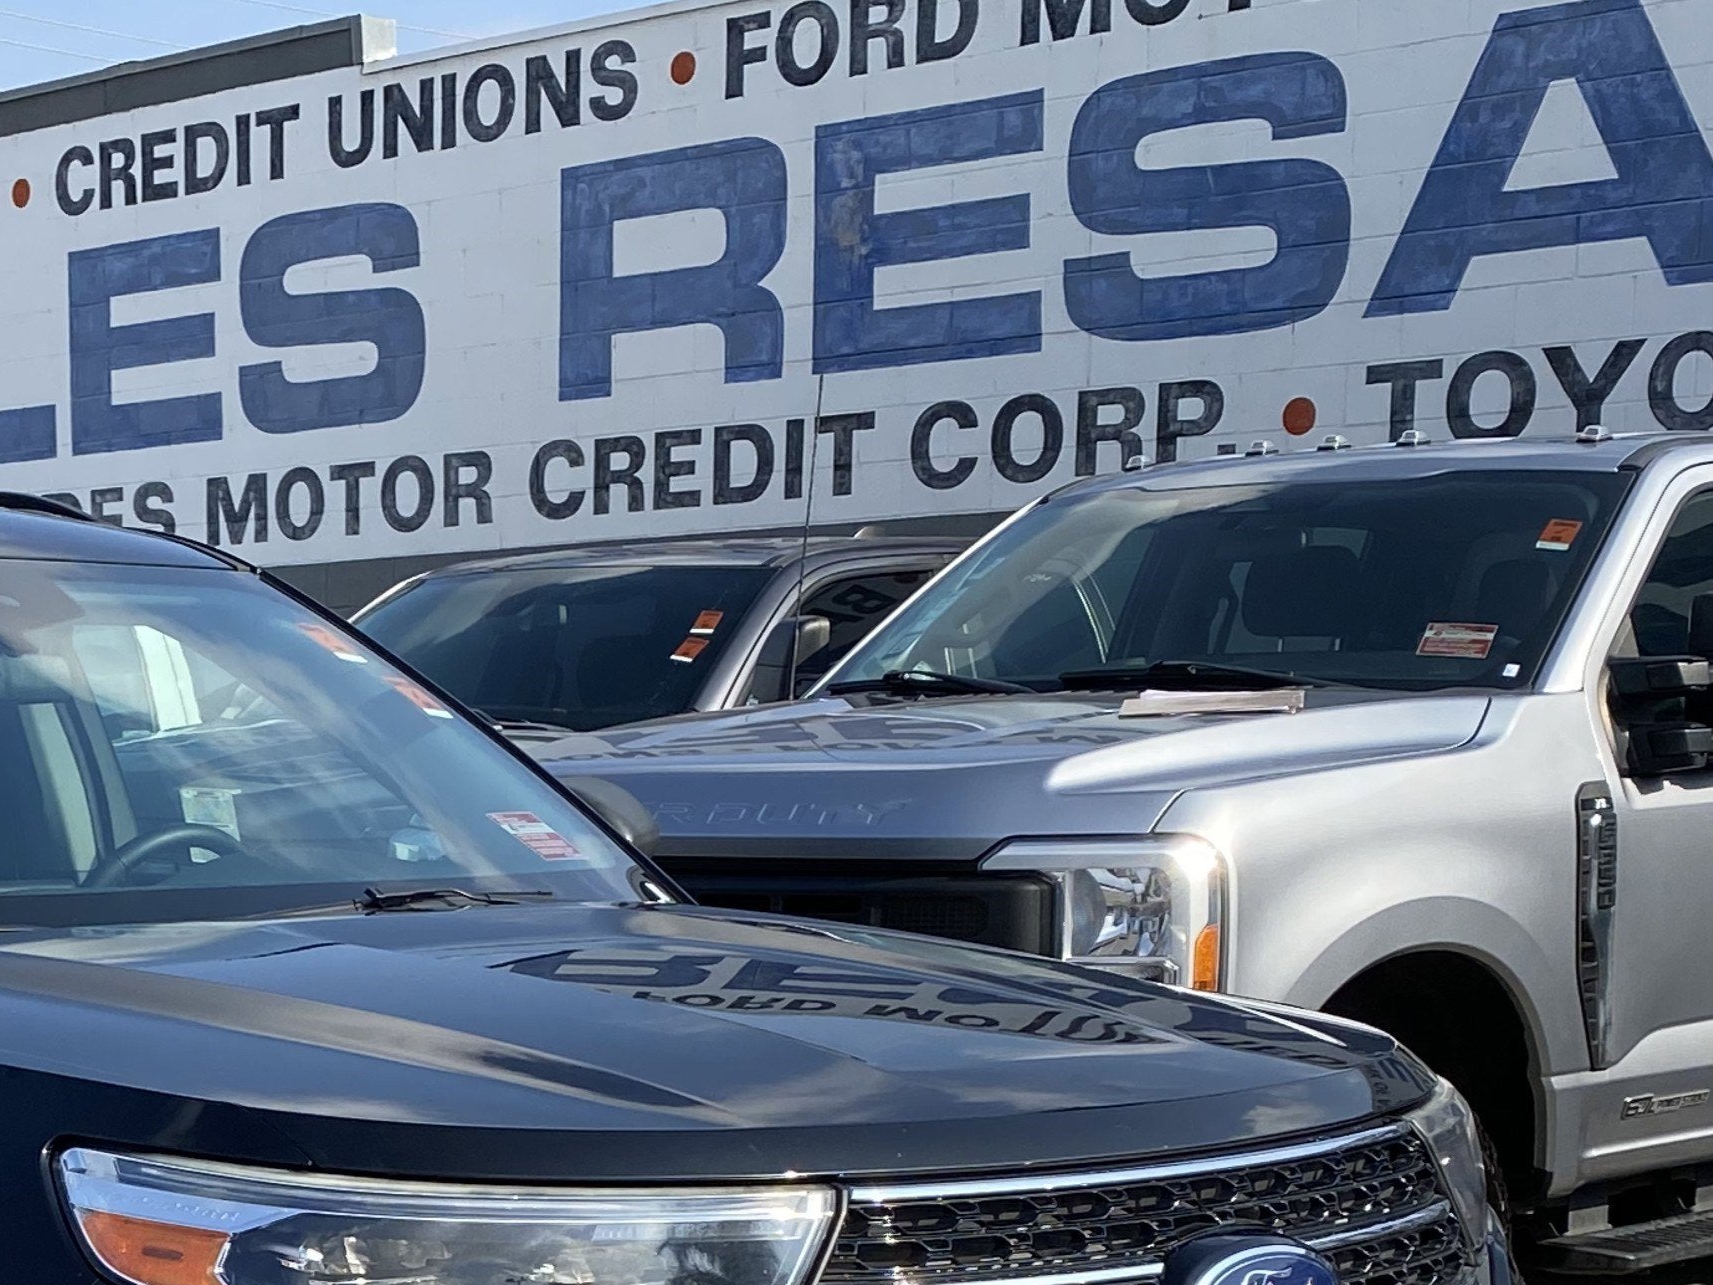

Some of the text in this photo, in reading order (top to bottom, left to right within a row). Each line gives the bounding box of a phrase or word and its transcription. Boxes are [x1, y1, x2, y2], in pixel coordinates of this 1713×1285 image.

[55, 103, 300, 216] CREDIT
[328, 39, 638, 169] UNIONS
[725, 0, 981, 100] FORD
[206, 450, 493, 546] MOTOR
[528, 411, 876, 520] CREDIT
[910, 378, 1237, 490] CORP.
